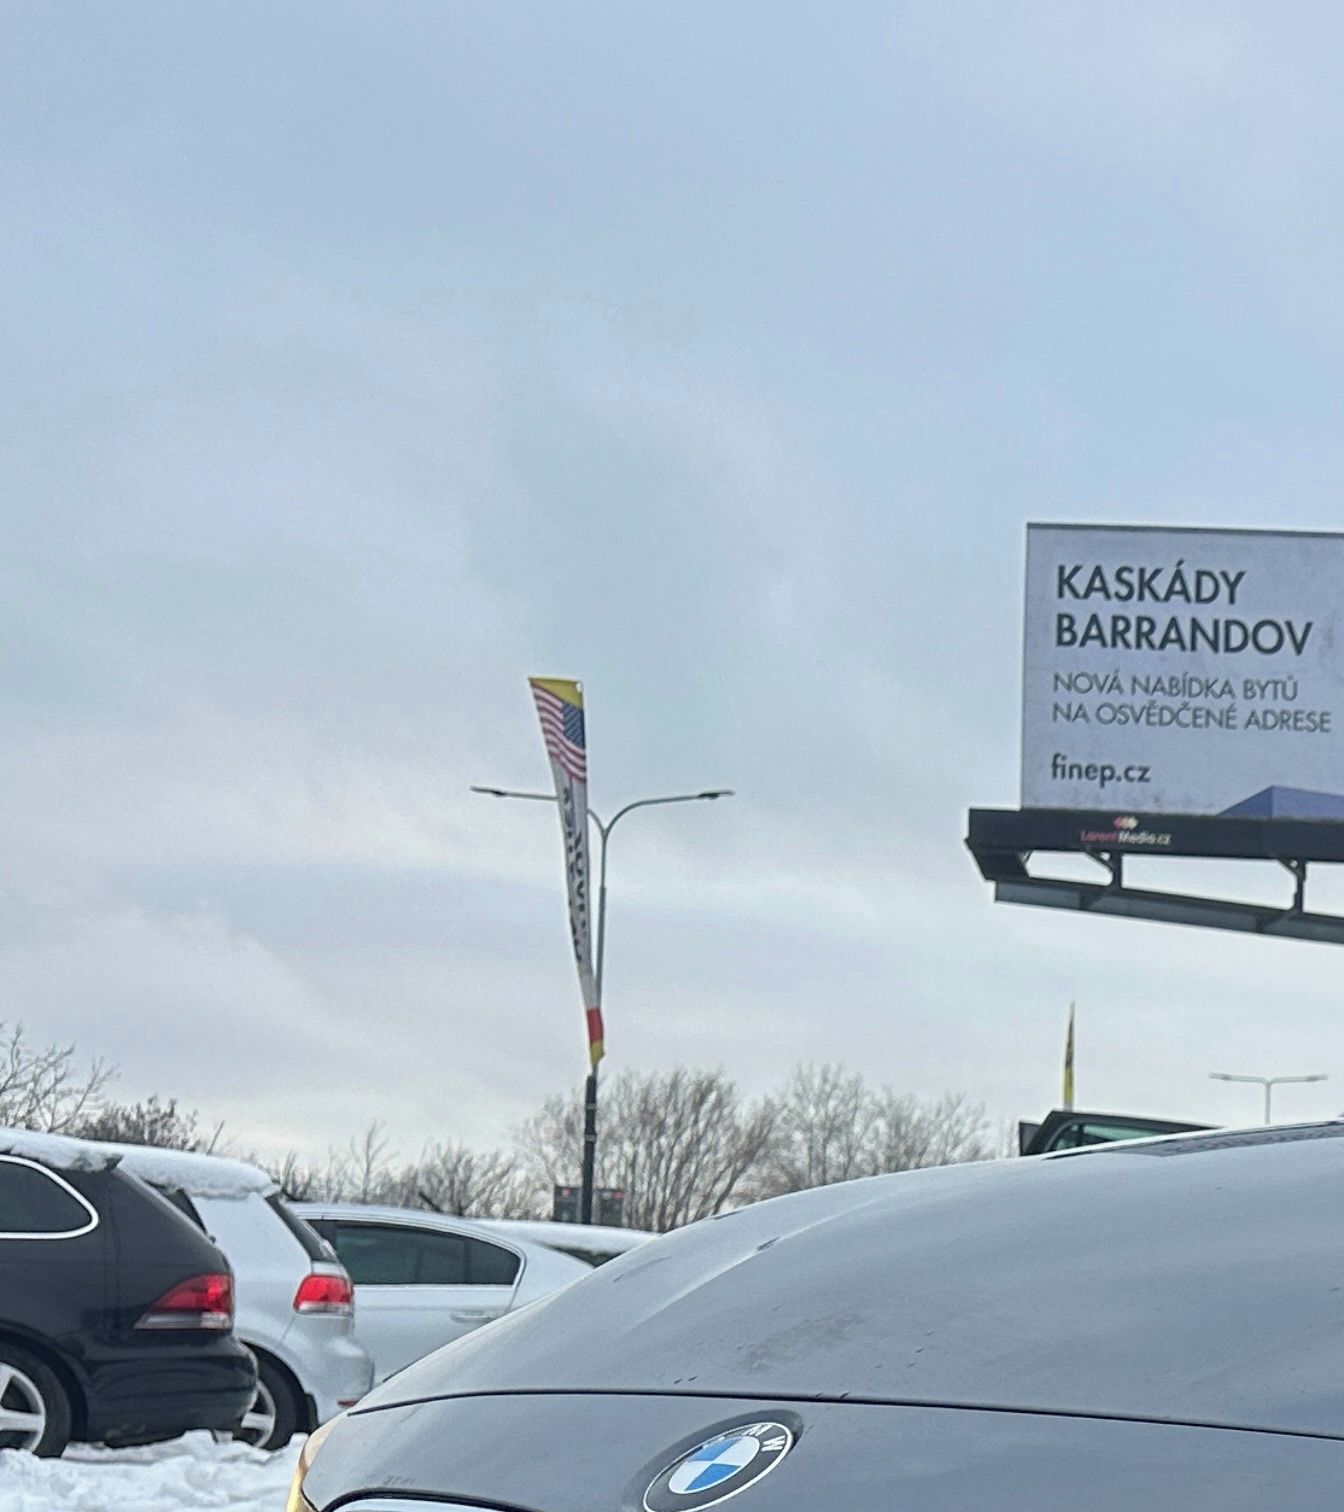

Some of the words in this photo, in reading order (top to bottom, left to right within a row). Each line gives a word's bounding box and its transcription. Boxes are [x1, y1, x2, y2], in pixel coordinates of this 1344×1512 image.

[1057, 558, 1246, 605] KASKÁDY
[1056, 613, 1314, 656] BARRANDOV
[1053, 669, 1124, 694] NOVÁ
[1131, 672, 1236, 700] NABÍDKA
[1243, 675, 1299, 701] BYTŮ
[1051, 702, 1090, 725] NA
[1095, 700, 1237, 730] OSVĚDČENÉ
[1244, 708, 1332, 733] ADRESE
[1051, 752, 1151, 788] finep.cz
